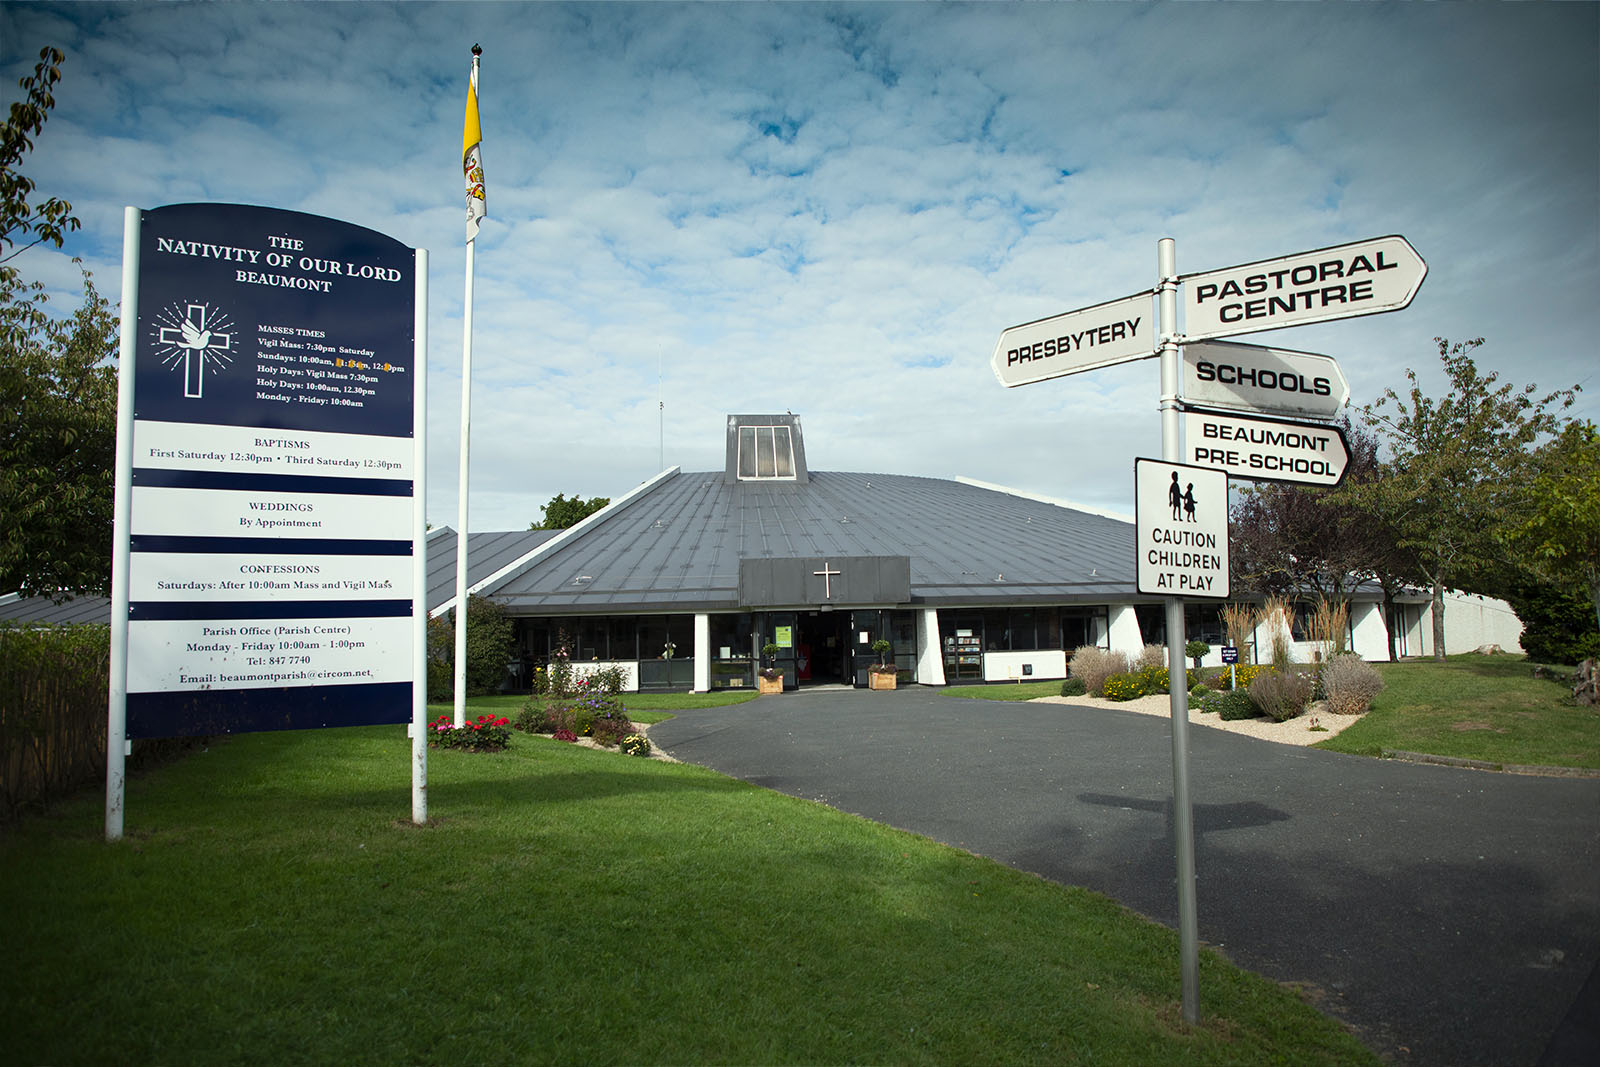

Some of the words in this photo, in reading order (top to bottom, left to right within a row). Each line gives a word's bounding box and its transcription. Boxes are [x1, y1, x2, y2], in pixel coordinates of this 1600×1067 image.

[268, 235, 304, 251] THE
[157, 237, 260, 264] NATIVITY
[266, 252, 293, 268] OF
[299, 257, 342, 275] OUR
[346, 263, 402, 282] LORD
[236, 270, 332, 293] BEAUMONT
[1196, 250, 1398, 304] PASTORAL
[1219, 279, 1375, 323] CENTRE
[258, 325, 294, 335] MASSES
[296, 328, 326, 338] TIMES
[258, 338, 278, 348] Vigil
[280, 340, 305, 350] Mass:
[306, 343, 336, 354] 7:30pm
[339, 346, 375, 358] Saturday
[1007, 316, 1141, 367] PRESBYTERY
[257, 351, 296, 363] Sundays:
[299, 355, 334, 367] 10:00am,
[372, 362, 405, 373] 12:0pm
[257, 365, 278, 375] Holy
[280, 366, 304, 377] Days:
[305, 369, 326, 379] Vigil
[327, 371, 348, 380] Mass
[349, 374, 378, 384] 7:30pm
[1195, 361, 1331, 396] SCHOOLS
[256, 378, 278, 388] Holy
[280, 380, 304, 390] Days:
[306, 382, 341, 393] 10:00am,
[256, 392, 291, 403] Monday
[298, 395, 329, 406] Friday:
[330, 398, 364, 408] 10:00am
[254, 438, 311, 450] BAPTISMS
[1203, 422, 1330, 452] BEAUMONT
[150, 448, 175, 459] First
[177, 450, 226, 463] Saturday
[229, 452, 273, 464] 12:30pm
[285, 455, 314, 466] Third
[316, 457, 361, 469] Saturday
[363, 459, 402, 470] 12:30pm
[1194, 448, 1337, 477] PRE-SCHOOL
[249, 502, 314, 512] WEDDINGS
[239, 517, 253, 528] By
[255, 518, 322, 529] Appointment
[1152, 528, 1216, 548] CAUTION
[240, 564, 320, 574] CONFESSIONS
[1148, 550, 1221, 570] CHILDREN
[157, 580, 216, 591] Saturdays:
[218, 580, 246, 590] After
[248, 580, 291, 590] 10:00am
[293, 580, 319, 590] Mass
[321, 580, 341, 590] and
[343, 580, 366, 592] Vigil
[368, 580, 393, 590] Mass
[1157, 573, 1174, 588] AT
[1179, 575, 1214, 591] PLAY
[203, 626, 237, 637] Parish
[239, 626, 271, 636] Office
[273, 625, 311, 637] (Parish
[313, 624, 352, 636] Centre)
[186, 642, 231, 653] Monday
[241, 641, 276, 652] Friday
[278, 640, 320, 650] 10:00am
[329, 640, 365, 650] 1:00pm
[246, 657, 267, 666] Tel:
[268, 656, 286, 665] 847
[288, 655, 311, 665] 7740
[180, 673, 217, 684] Email:
